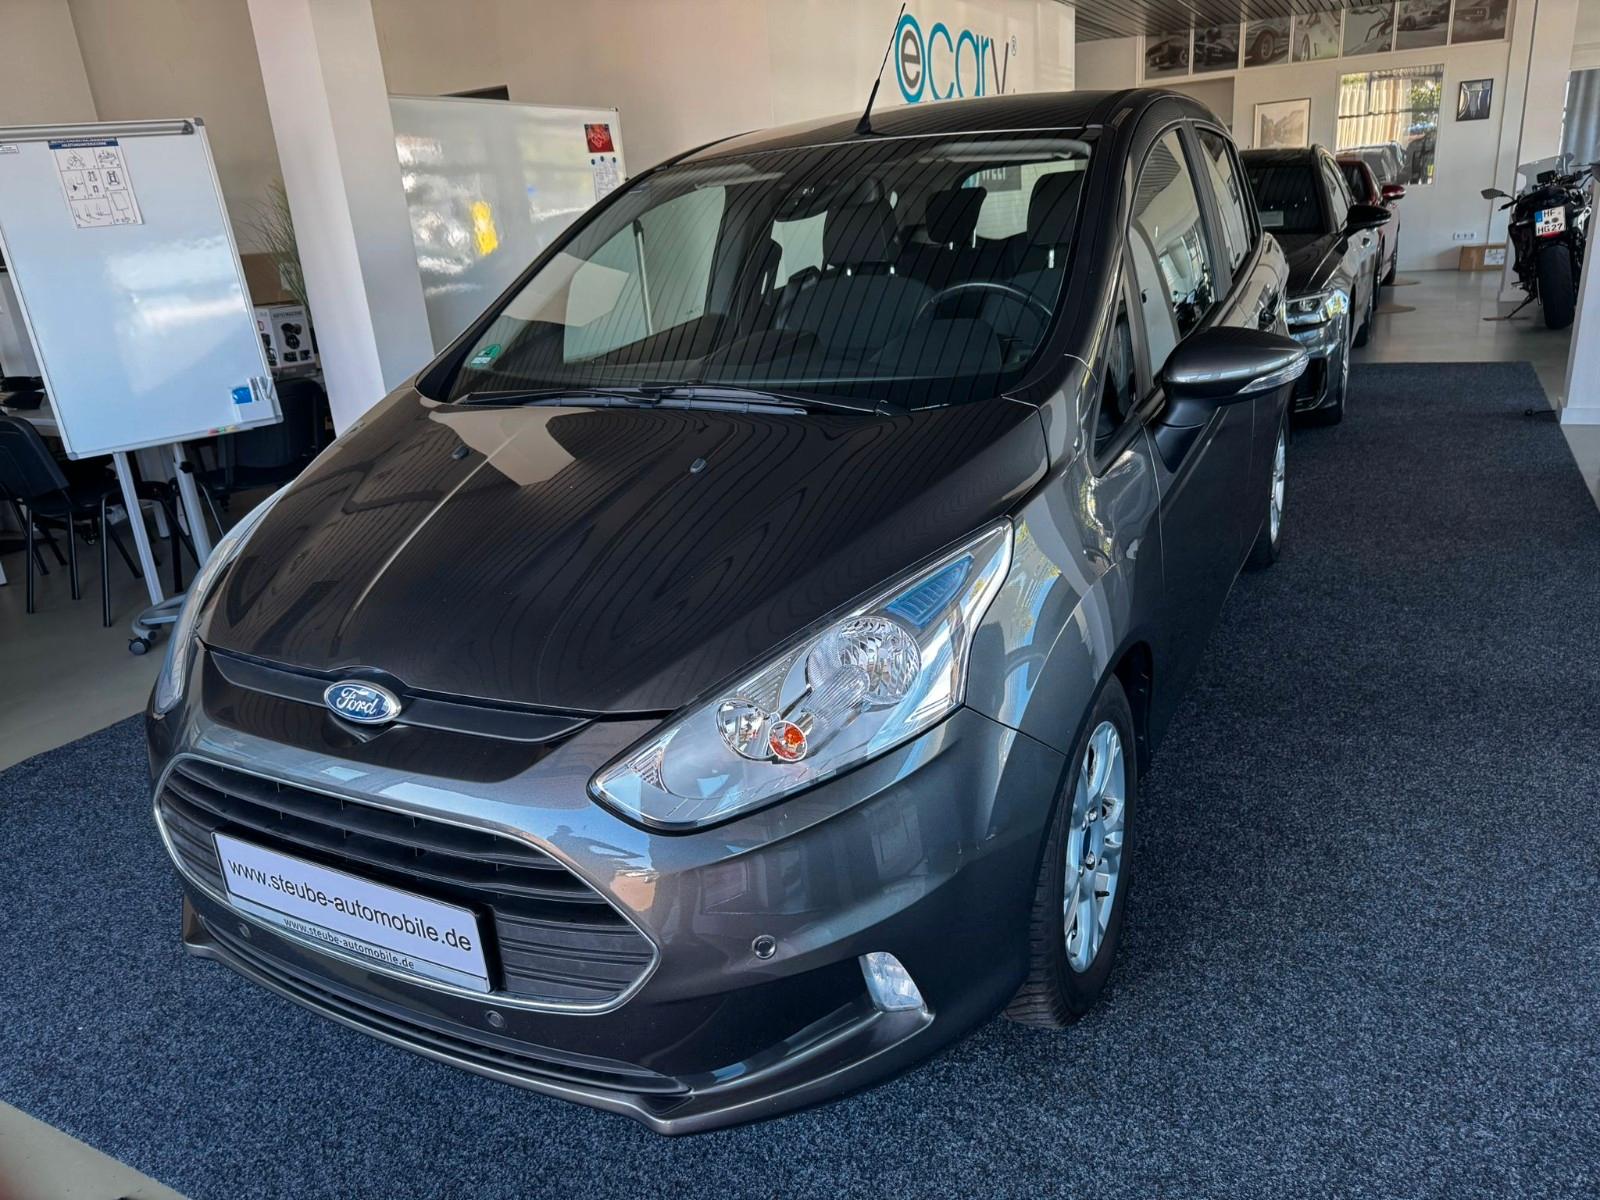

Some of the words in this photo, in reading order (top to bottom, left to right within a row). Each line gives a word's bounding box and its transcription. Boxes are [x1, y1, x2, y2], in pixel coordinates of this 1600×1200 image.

[336, 687, 379, 715] Ford
[228, 859, 472, 952] www.steube-automobile.de
[283, 917, 415, 970] www.steube-automobile.de
